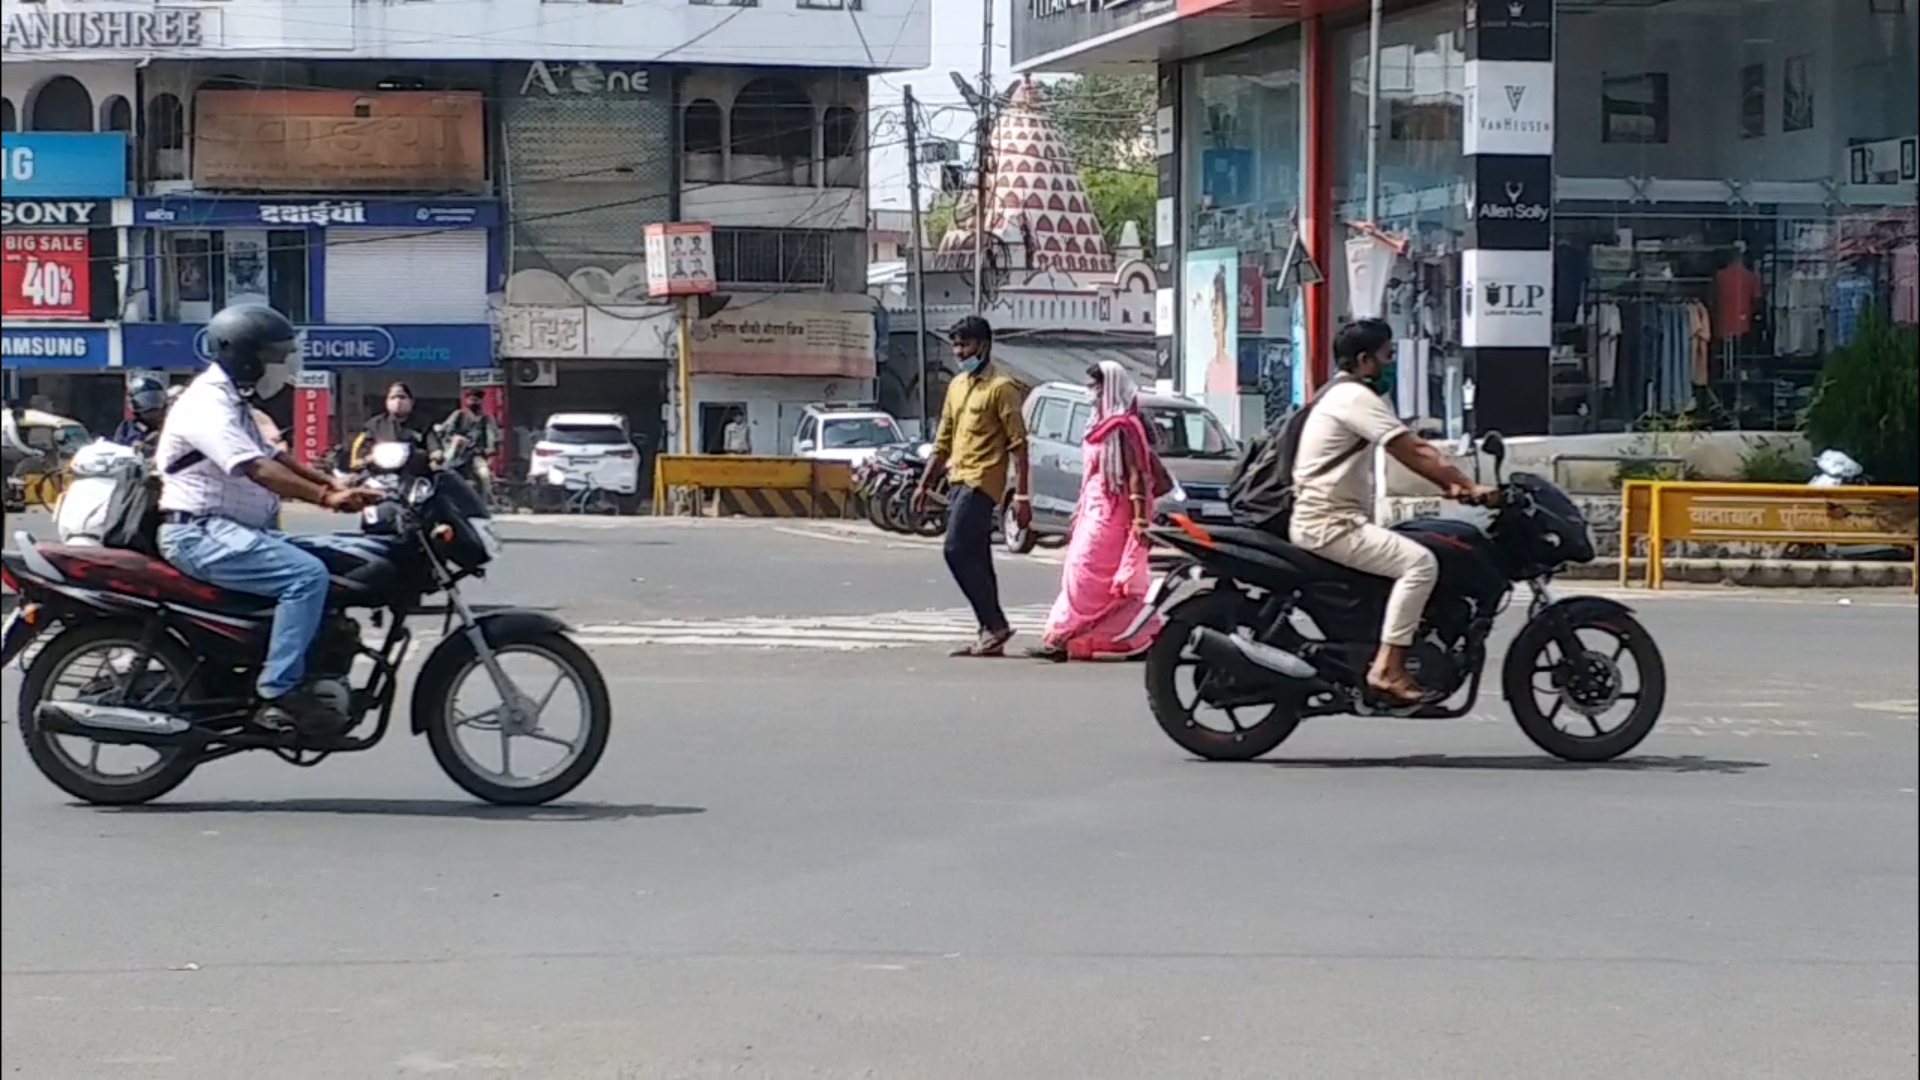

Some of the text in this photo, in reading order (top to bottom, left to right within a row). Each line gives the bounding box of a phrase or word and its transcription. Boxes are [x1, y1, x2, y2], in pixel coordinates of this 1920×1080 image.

[2, 10, 203, 49] ANUSHREE
[2, 201, 97, 224] SONY
[1478, 203, 1550, 222] Allen Solly
[5, 236, 84, 252] BIG SALE
[1505, 284, 1546, 308] LP
[2, 337, 87, 357] AMSUNG
[301, 339, 450, 360] EDICINE centre
[304, 389, 318, 461] DISCOU
[1687, 506, 1766, 526] यातायात
